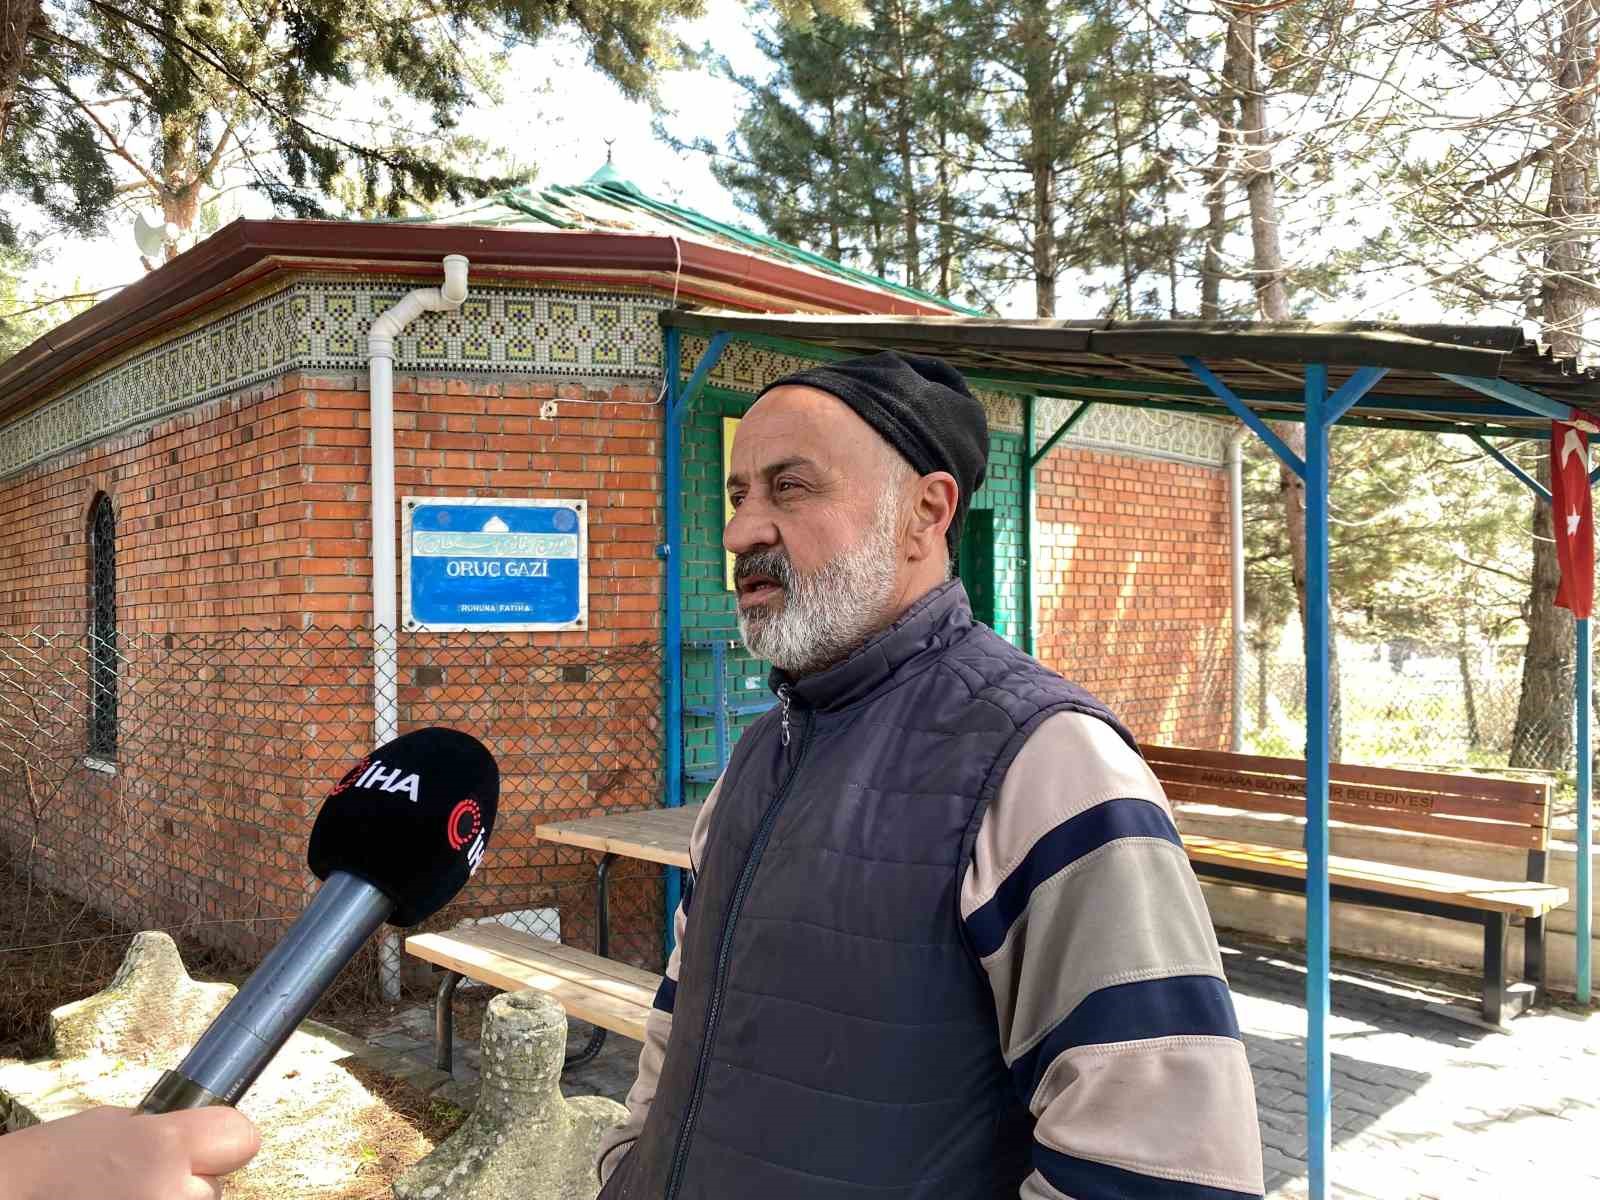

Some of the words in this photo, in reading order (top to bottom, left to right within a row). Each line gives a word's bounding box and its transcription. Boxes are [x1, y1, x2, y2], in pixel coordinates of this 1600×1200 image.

[504, 560, 549, 577] GAZİ
[354, 760, 420, 802] İHA
[1346, 787, 1435, 809] BELEDİYESİ
